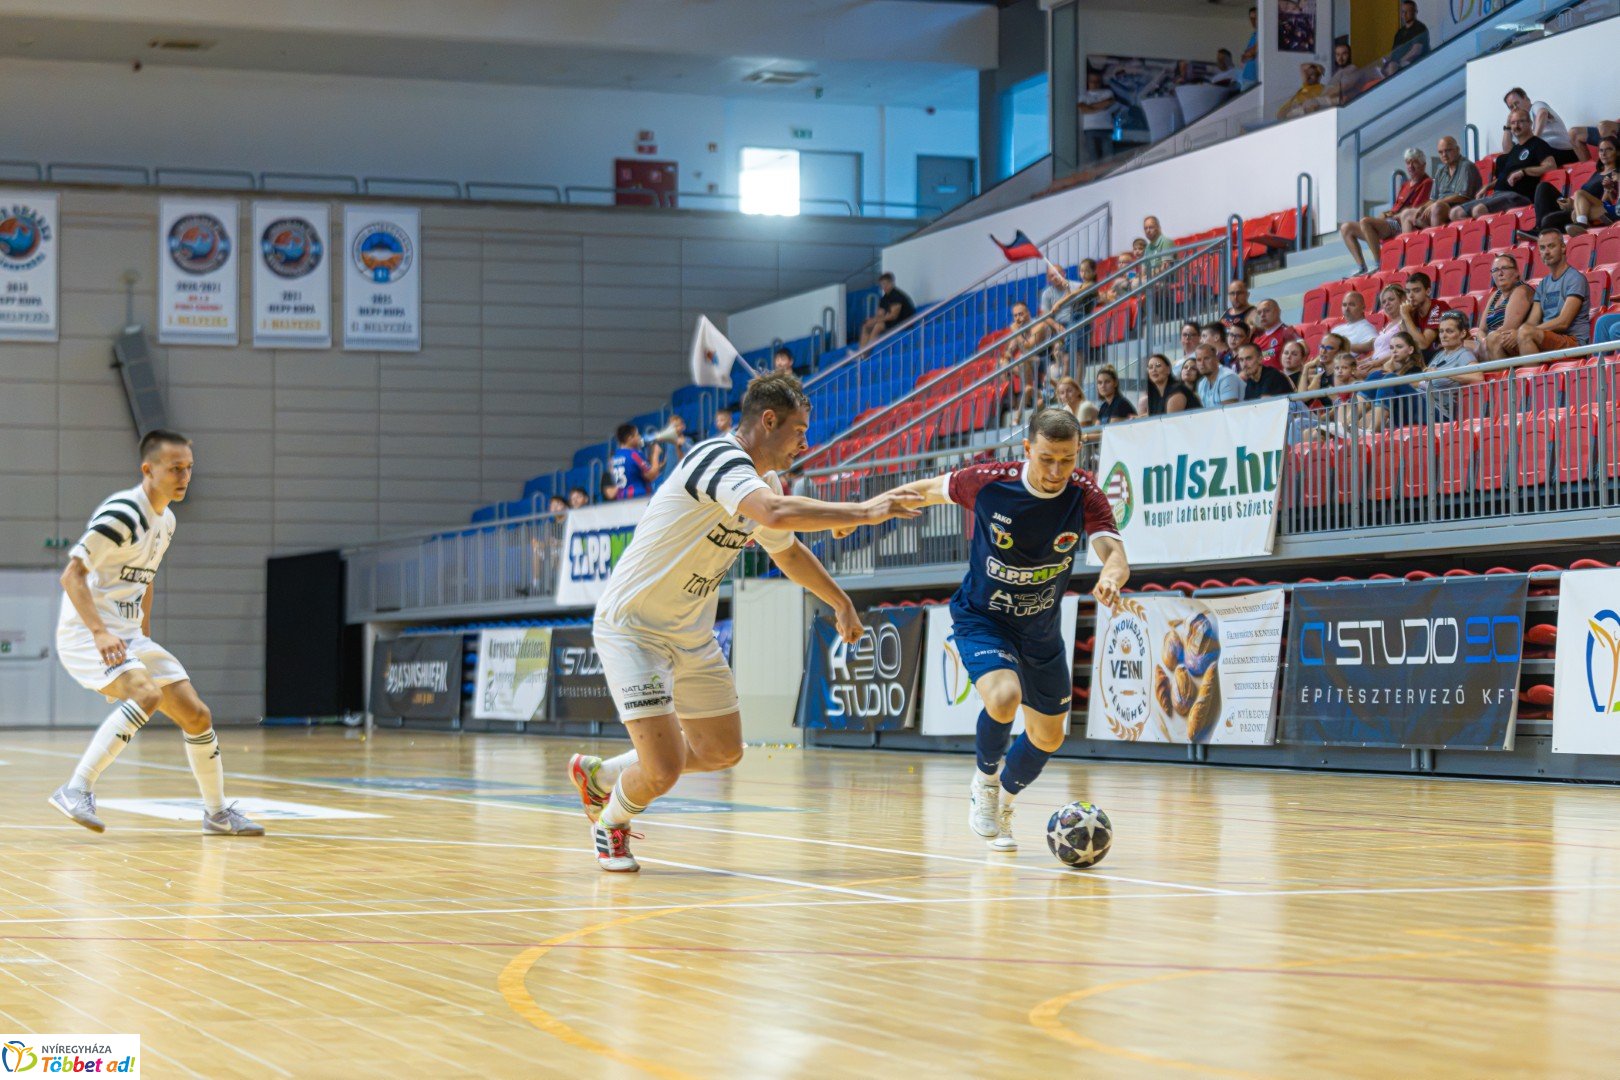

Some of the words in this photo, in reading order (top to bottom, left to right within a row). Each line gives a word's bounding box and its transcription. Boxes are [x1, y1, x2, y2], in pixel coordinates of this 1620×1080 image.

[1143, 446, 1282, 504] mlsz.hu
[992, 512, 1012, 525] JAKO
[1144, 511, 1173, 527] Magyar
[1176, 503, 1233, 523] Labdarúgó
[988, 598, 1055, 617] STUDIO
[1464, 615, 1522, 664] 90
[826, 682, 906, 717] STUDIO
[1301, 684, 1465, 705] ÉPÍTÉSZTERVEZŐ
